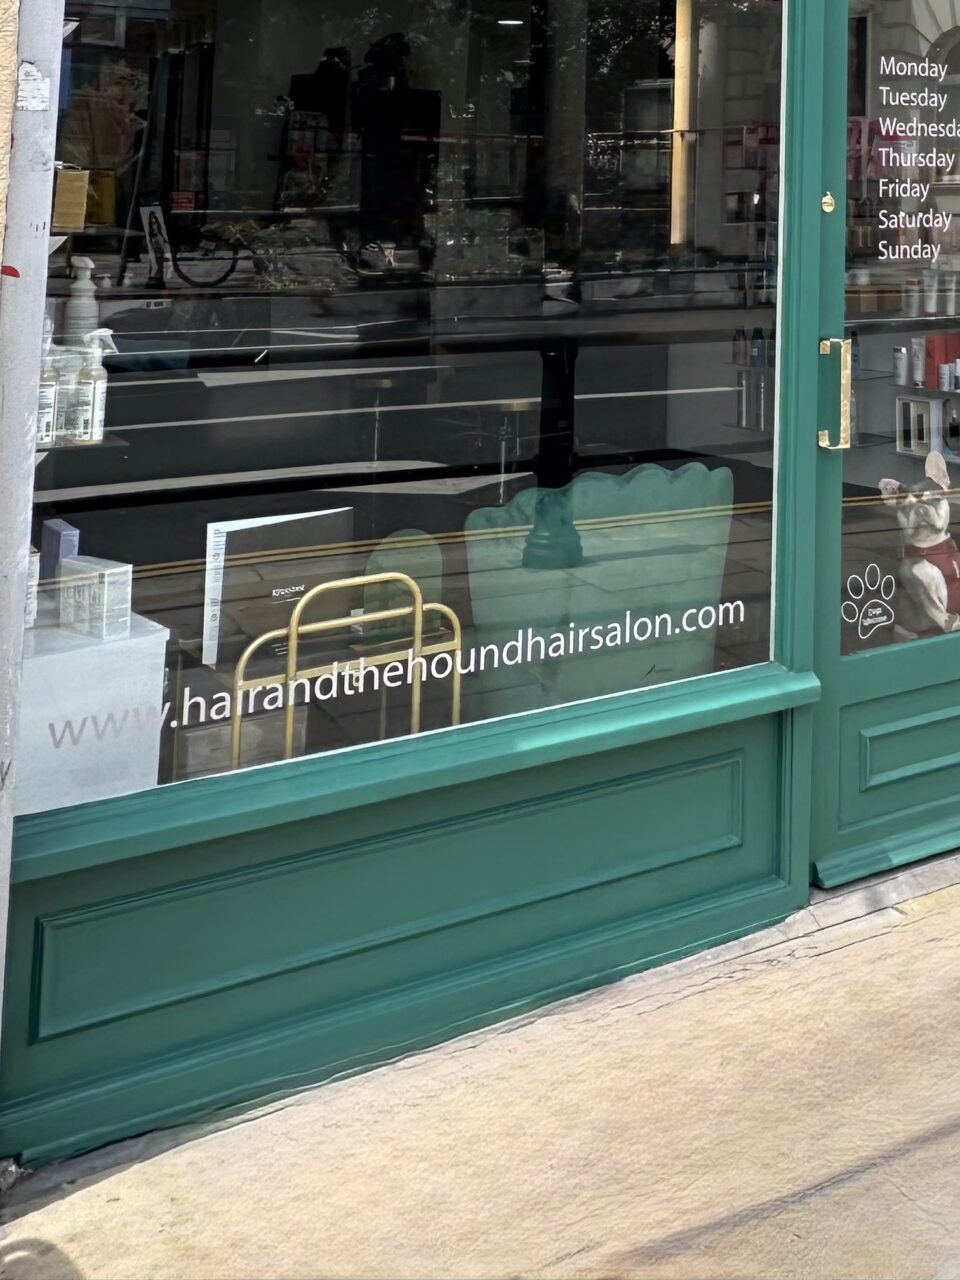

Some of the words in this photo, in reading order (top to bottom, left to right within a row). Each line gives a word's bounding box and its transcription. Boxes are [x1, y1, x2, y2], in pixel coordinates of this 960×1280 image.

[879, 56, 948, 81] Monday
[879, 86, 948, 111] Tuesday
[879, 148, 955, 172] Thursday
[879, 179, 930, 202] Friday
[878, 209, 952, 232] Saturday
[878, 241, 941, 261] Sunday
